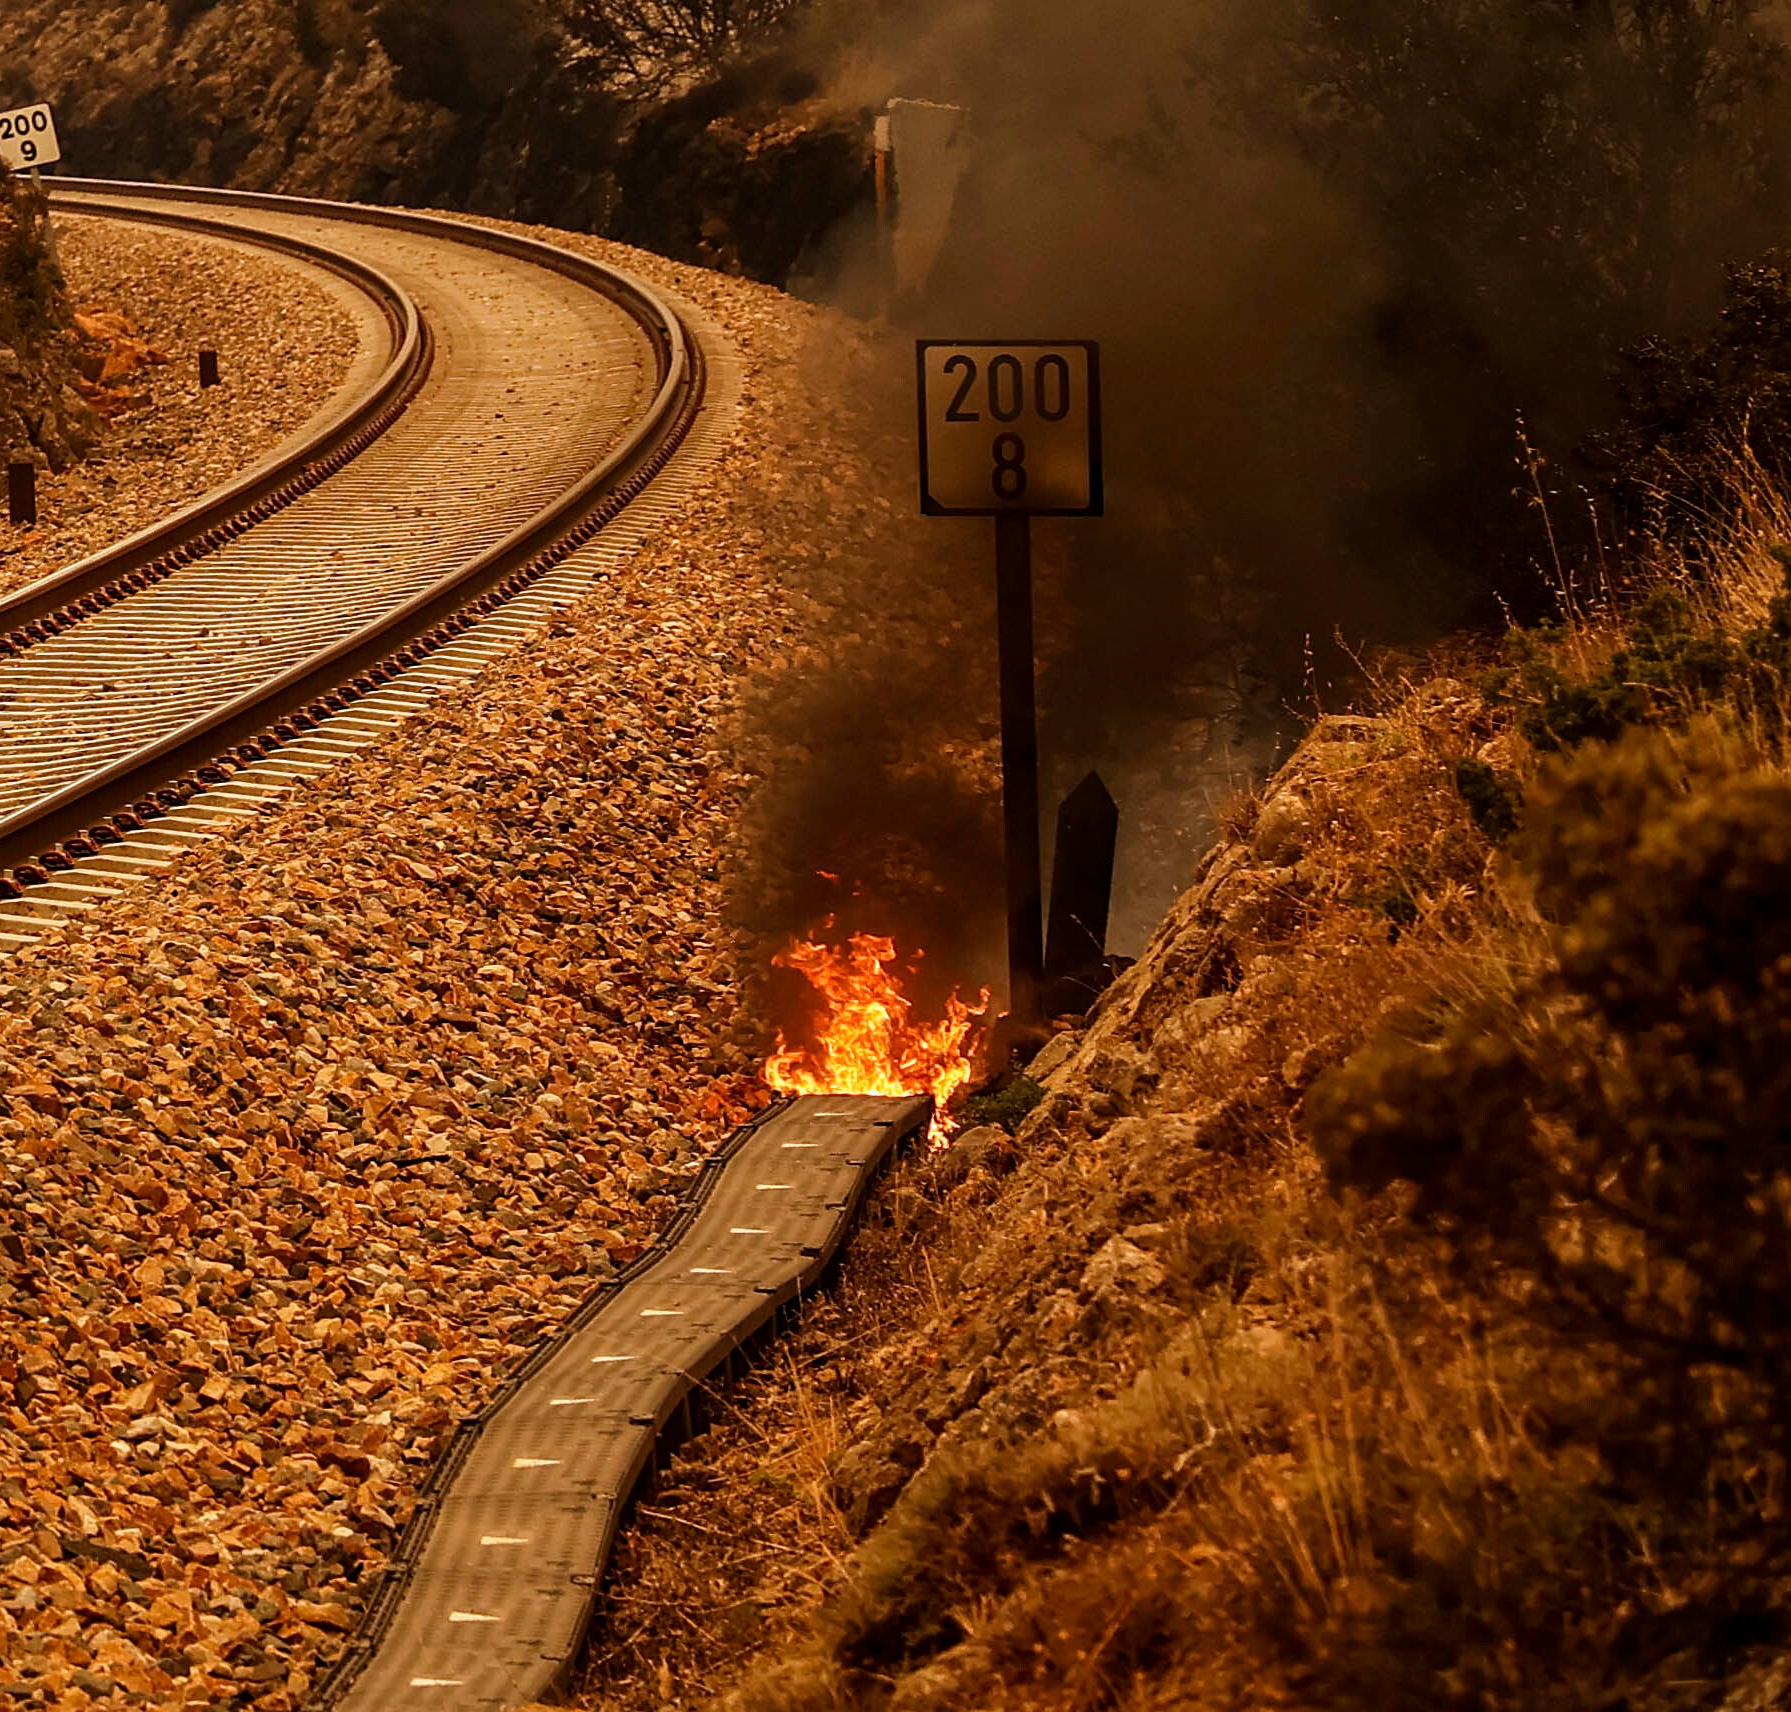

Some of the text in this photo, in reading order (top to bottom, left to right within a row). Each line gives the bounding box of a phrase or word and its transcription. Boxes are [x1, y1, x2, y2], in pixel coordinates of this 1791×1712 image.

[20, 140, 37, 161] 9
[943, 354, 1070, 422] 200
[991, 432, 1027, 500] 8
